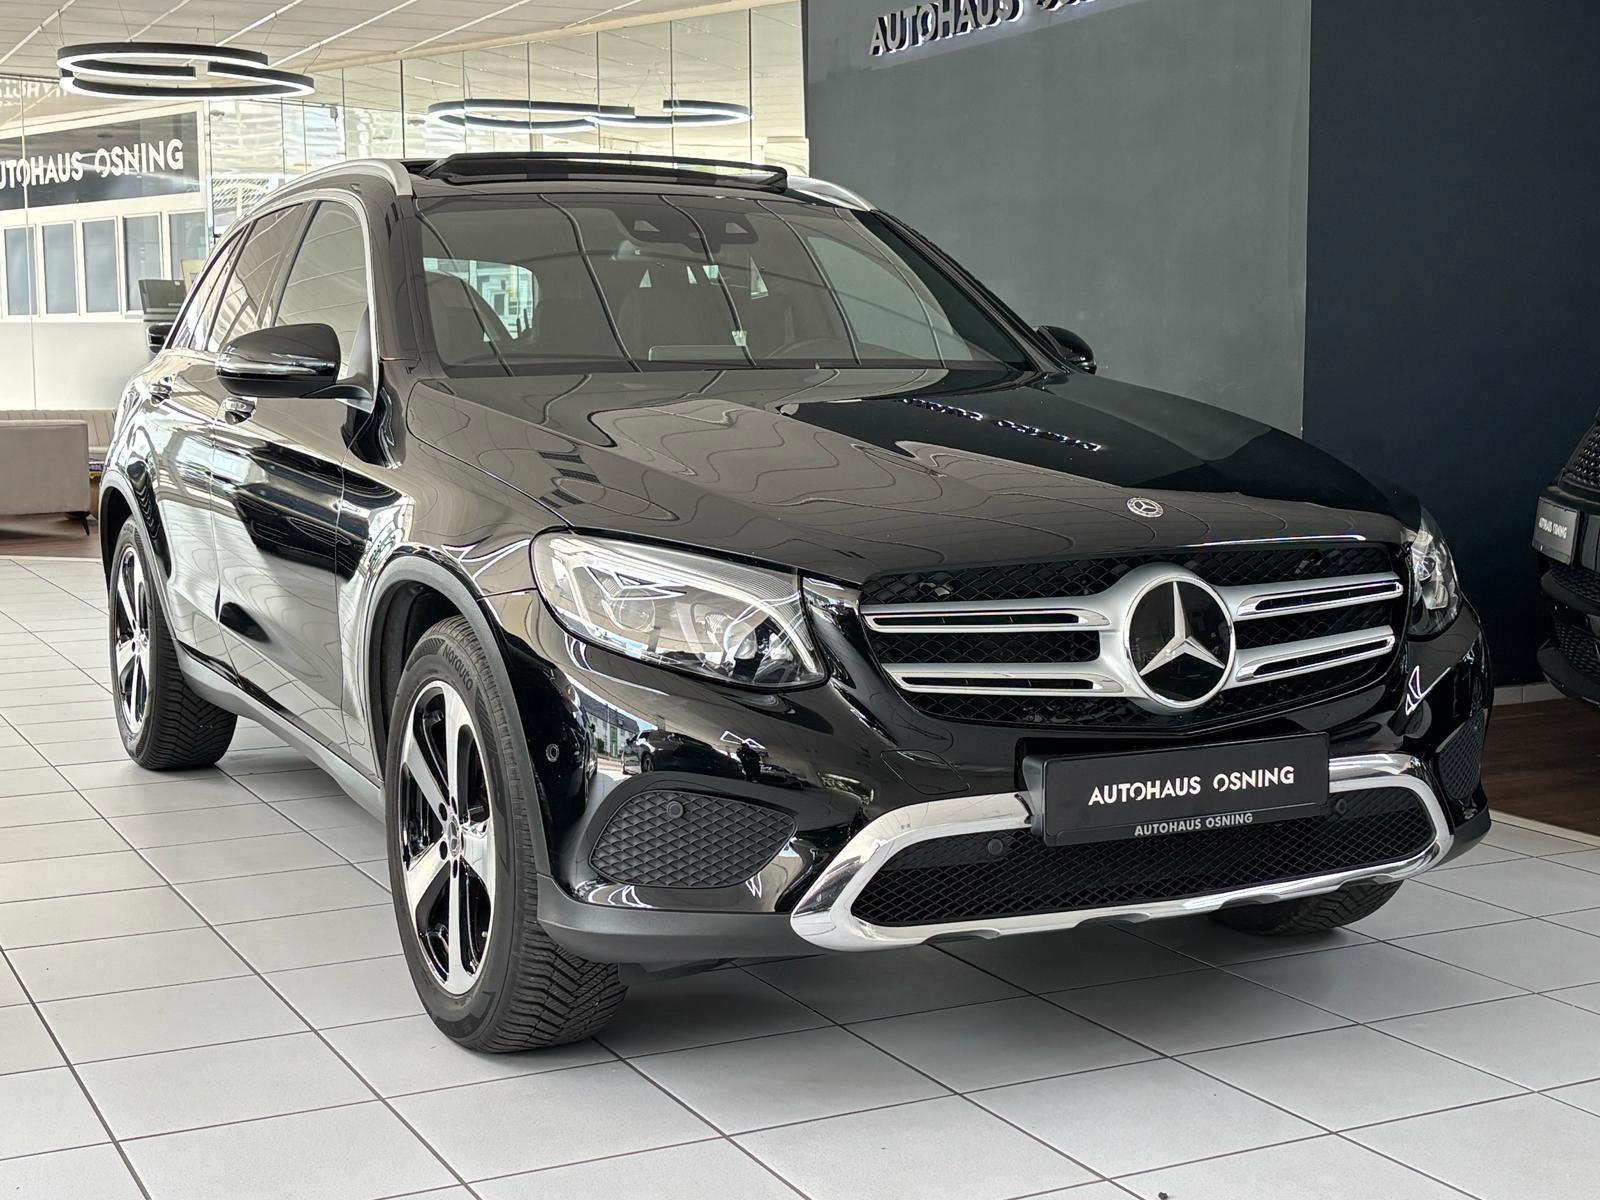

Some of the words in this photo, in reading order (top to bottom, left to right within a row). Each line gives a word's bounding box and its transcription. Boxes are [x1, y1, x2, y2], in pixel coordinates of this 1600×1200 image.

[94, 138, 183, 179] OSNING
[442, 644, 474, 691] Norauto
[1087, 775, 1202, 806] AUTOHAUS
[1212, 765, 1295, 792] OSNING
[1134, 818, 1202, 837] AUTOHAUS
[1205, 812, 1254, 829] OSNING
